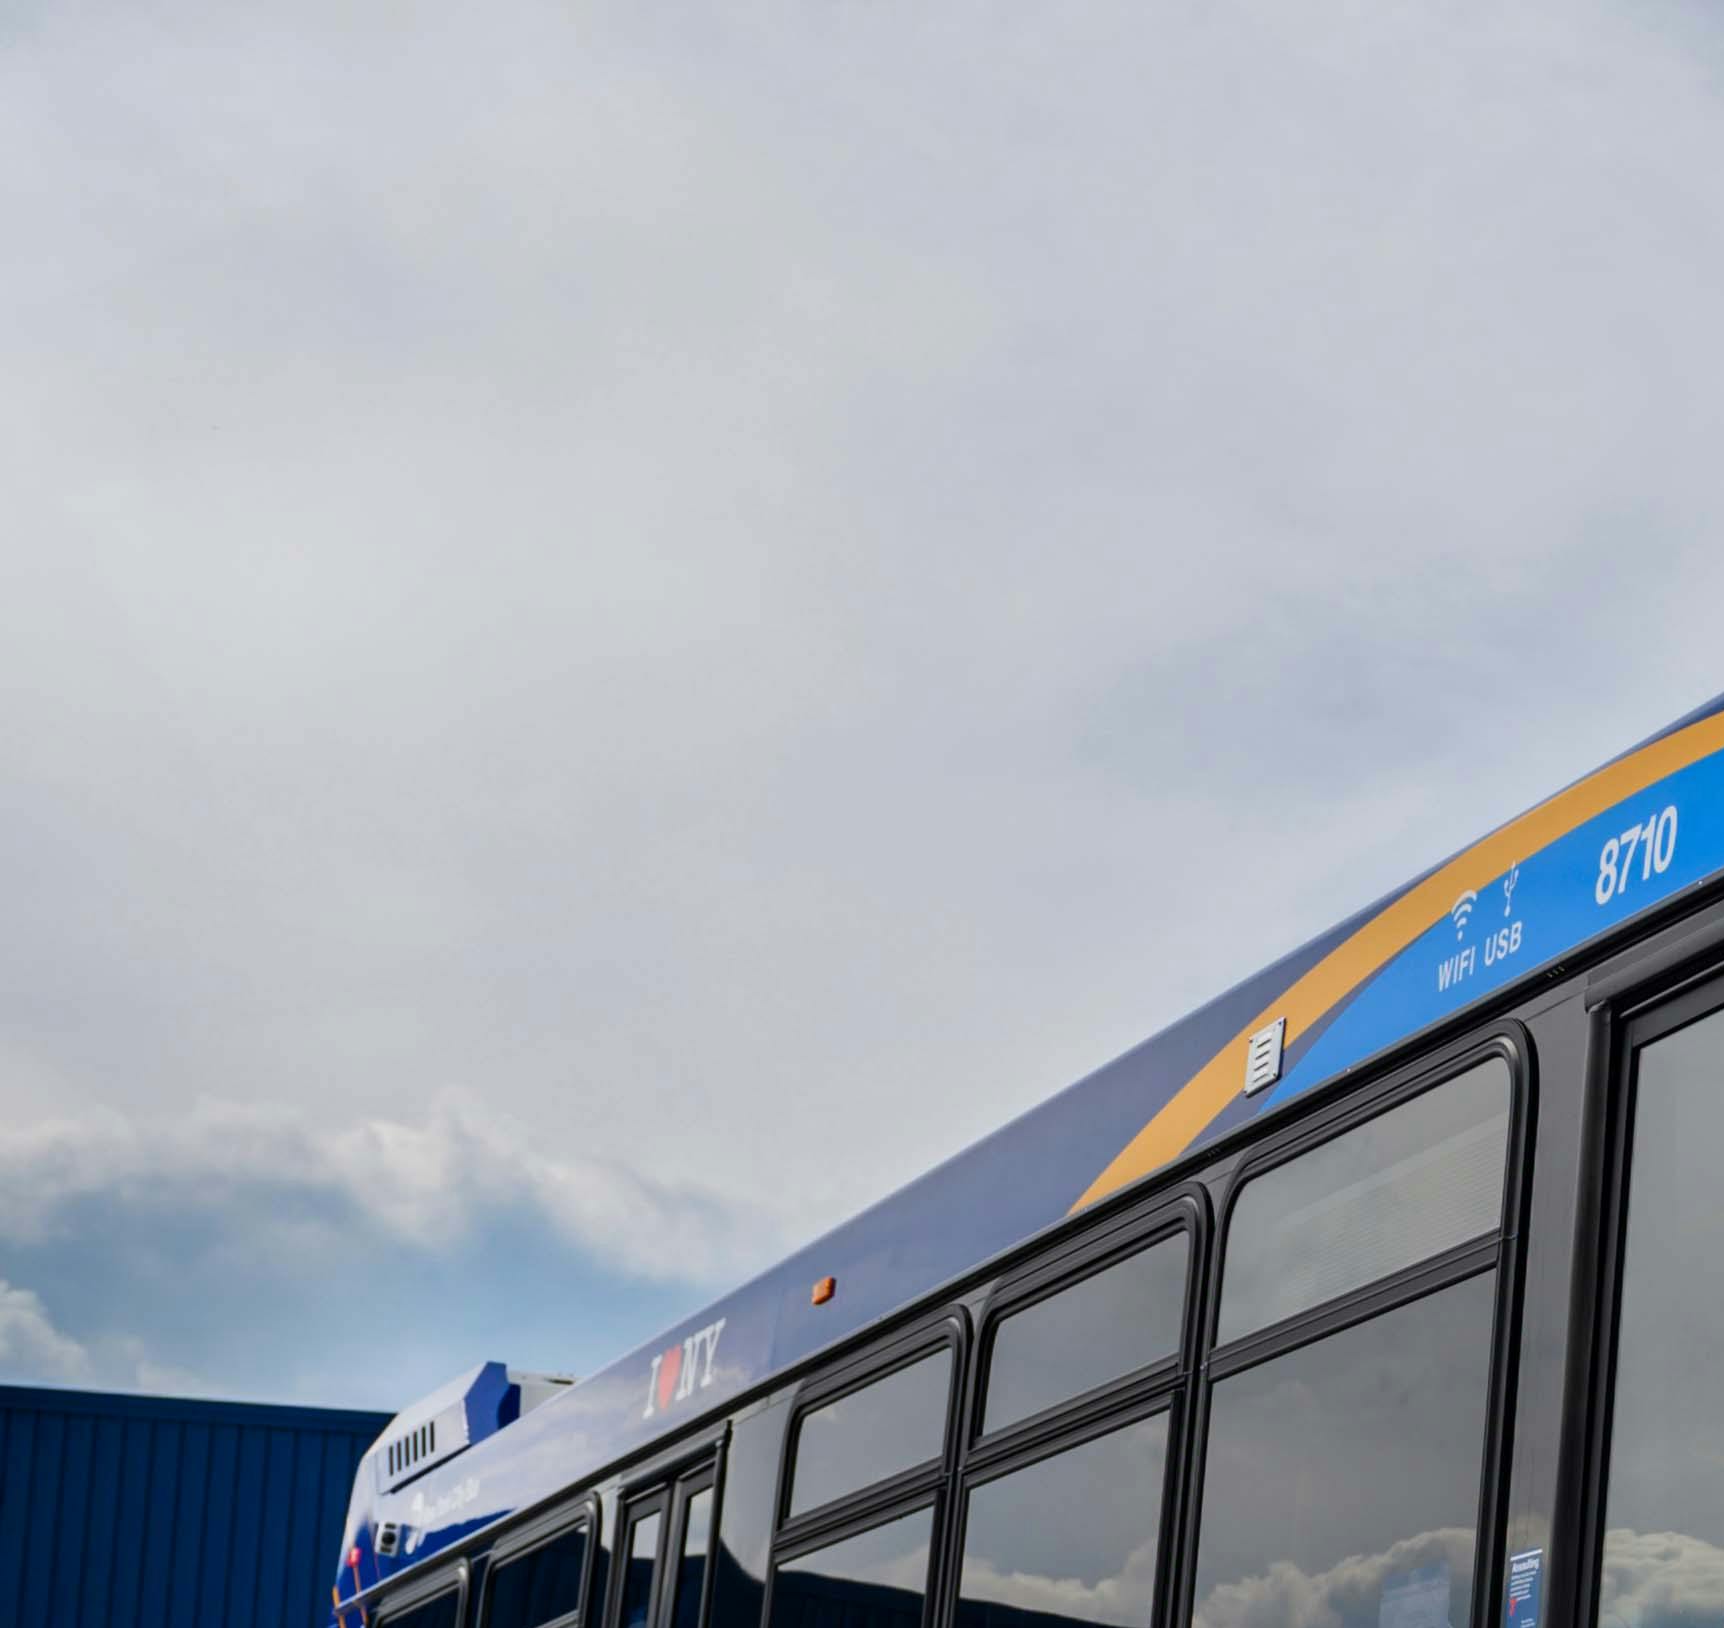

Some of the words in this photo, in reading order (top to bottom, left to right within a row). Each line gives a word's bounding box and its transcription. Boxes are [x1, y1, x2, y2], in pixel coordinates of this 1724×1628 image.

[1595, 806, 1678, 905] 8710
[1438, 945, 1476, 992] WIFI
[1483, 920, 1523, 967] USB
[676, 1317, 727, 1401] NY
